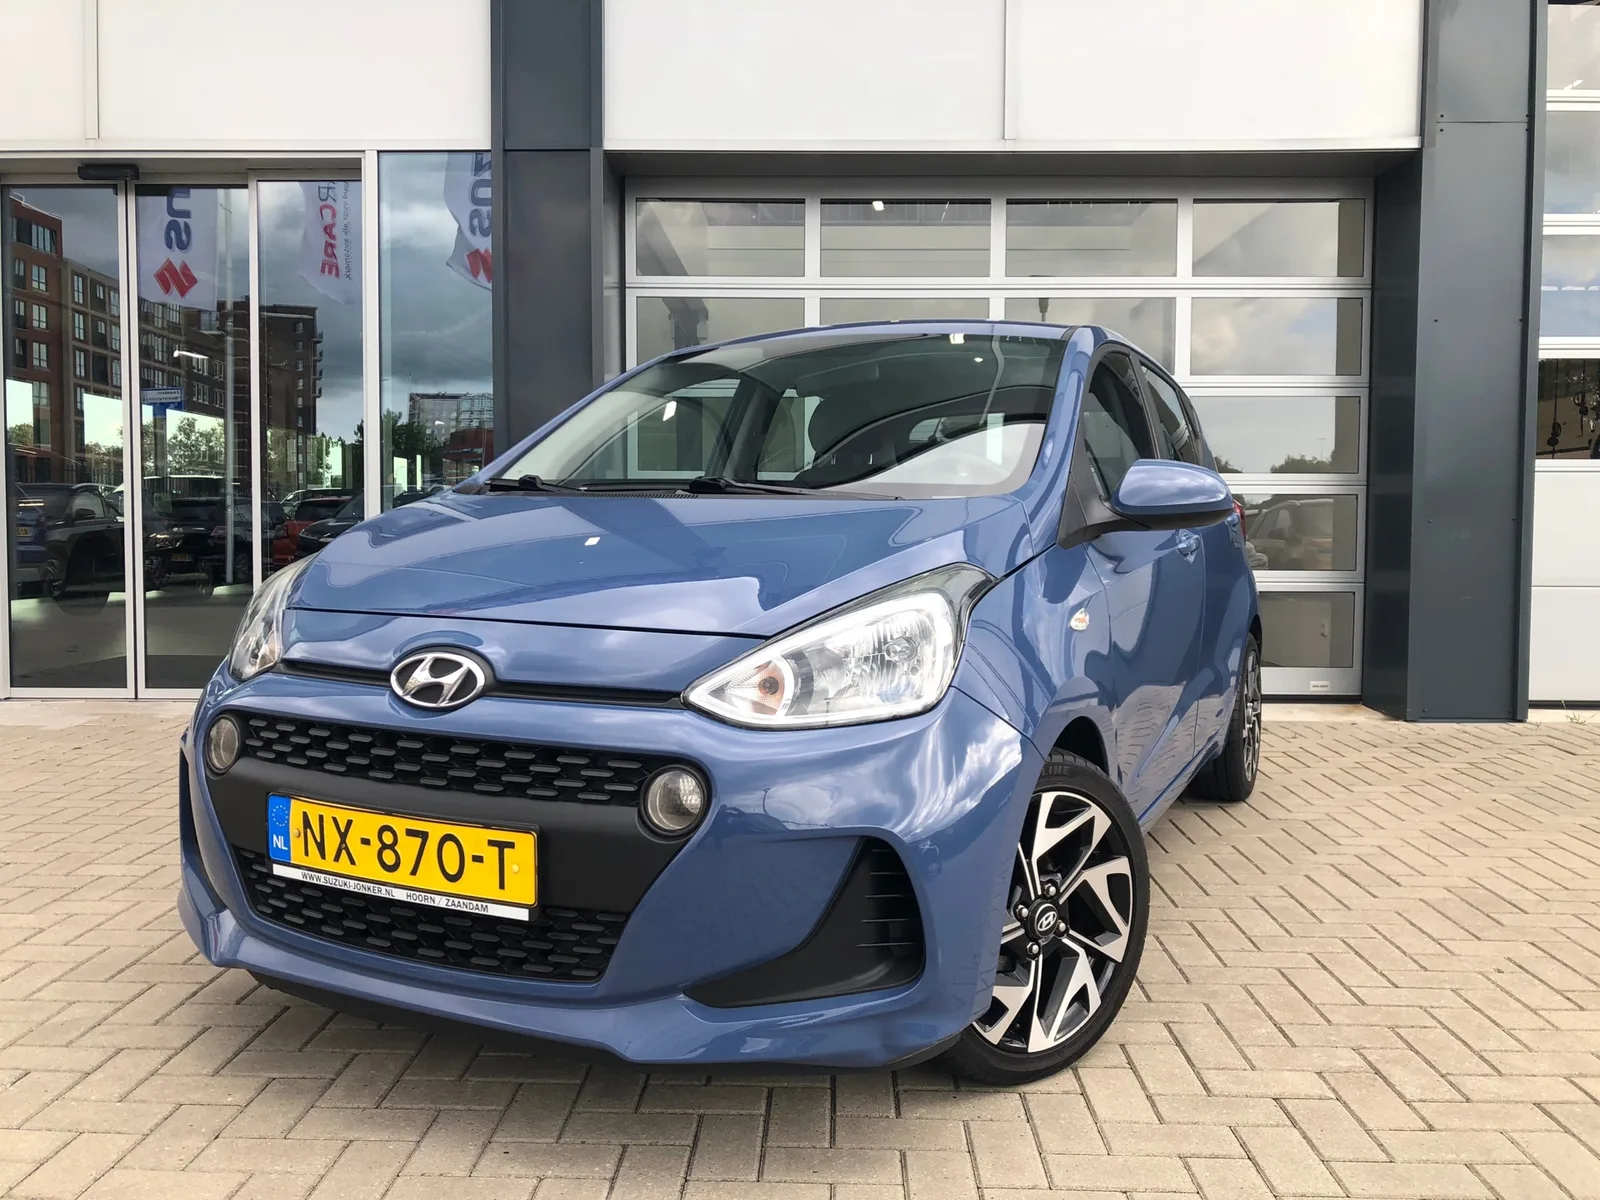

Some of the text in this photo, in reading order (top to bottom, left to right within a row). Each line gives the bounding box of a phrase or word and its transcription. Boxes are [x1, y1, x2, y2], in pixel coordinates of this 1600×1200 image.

[272, 834, 289, 850] NL
[302, 810, 515, 890] NX-870-T
[301, 871, 395, 898] WWW.SUZUKI-JONKER.NL
[406, 892, 436, 905] HOORN
[445, 898, 489, 913] ZAANDAM
